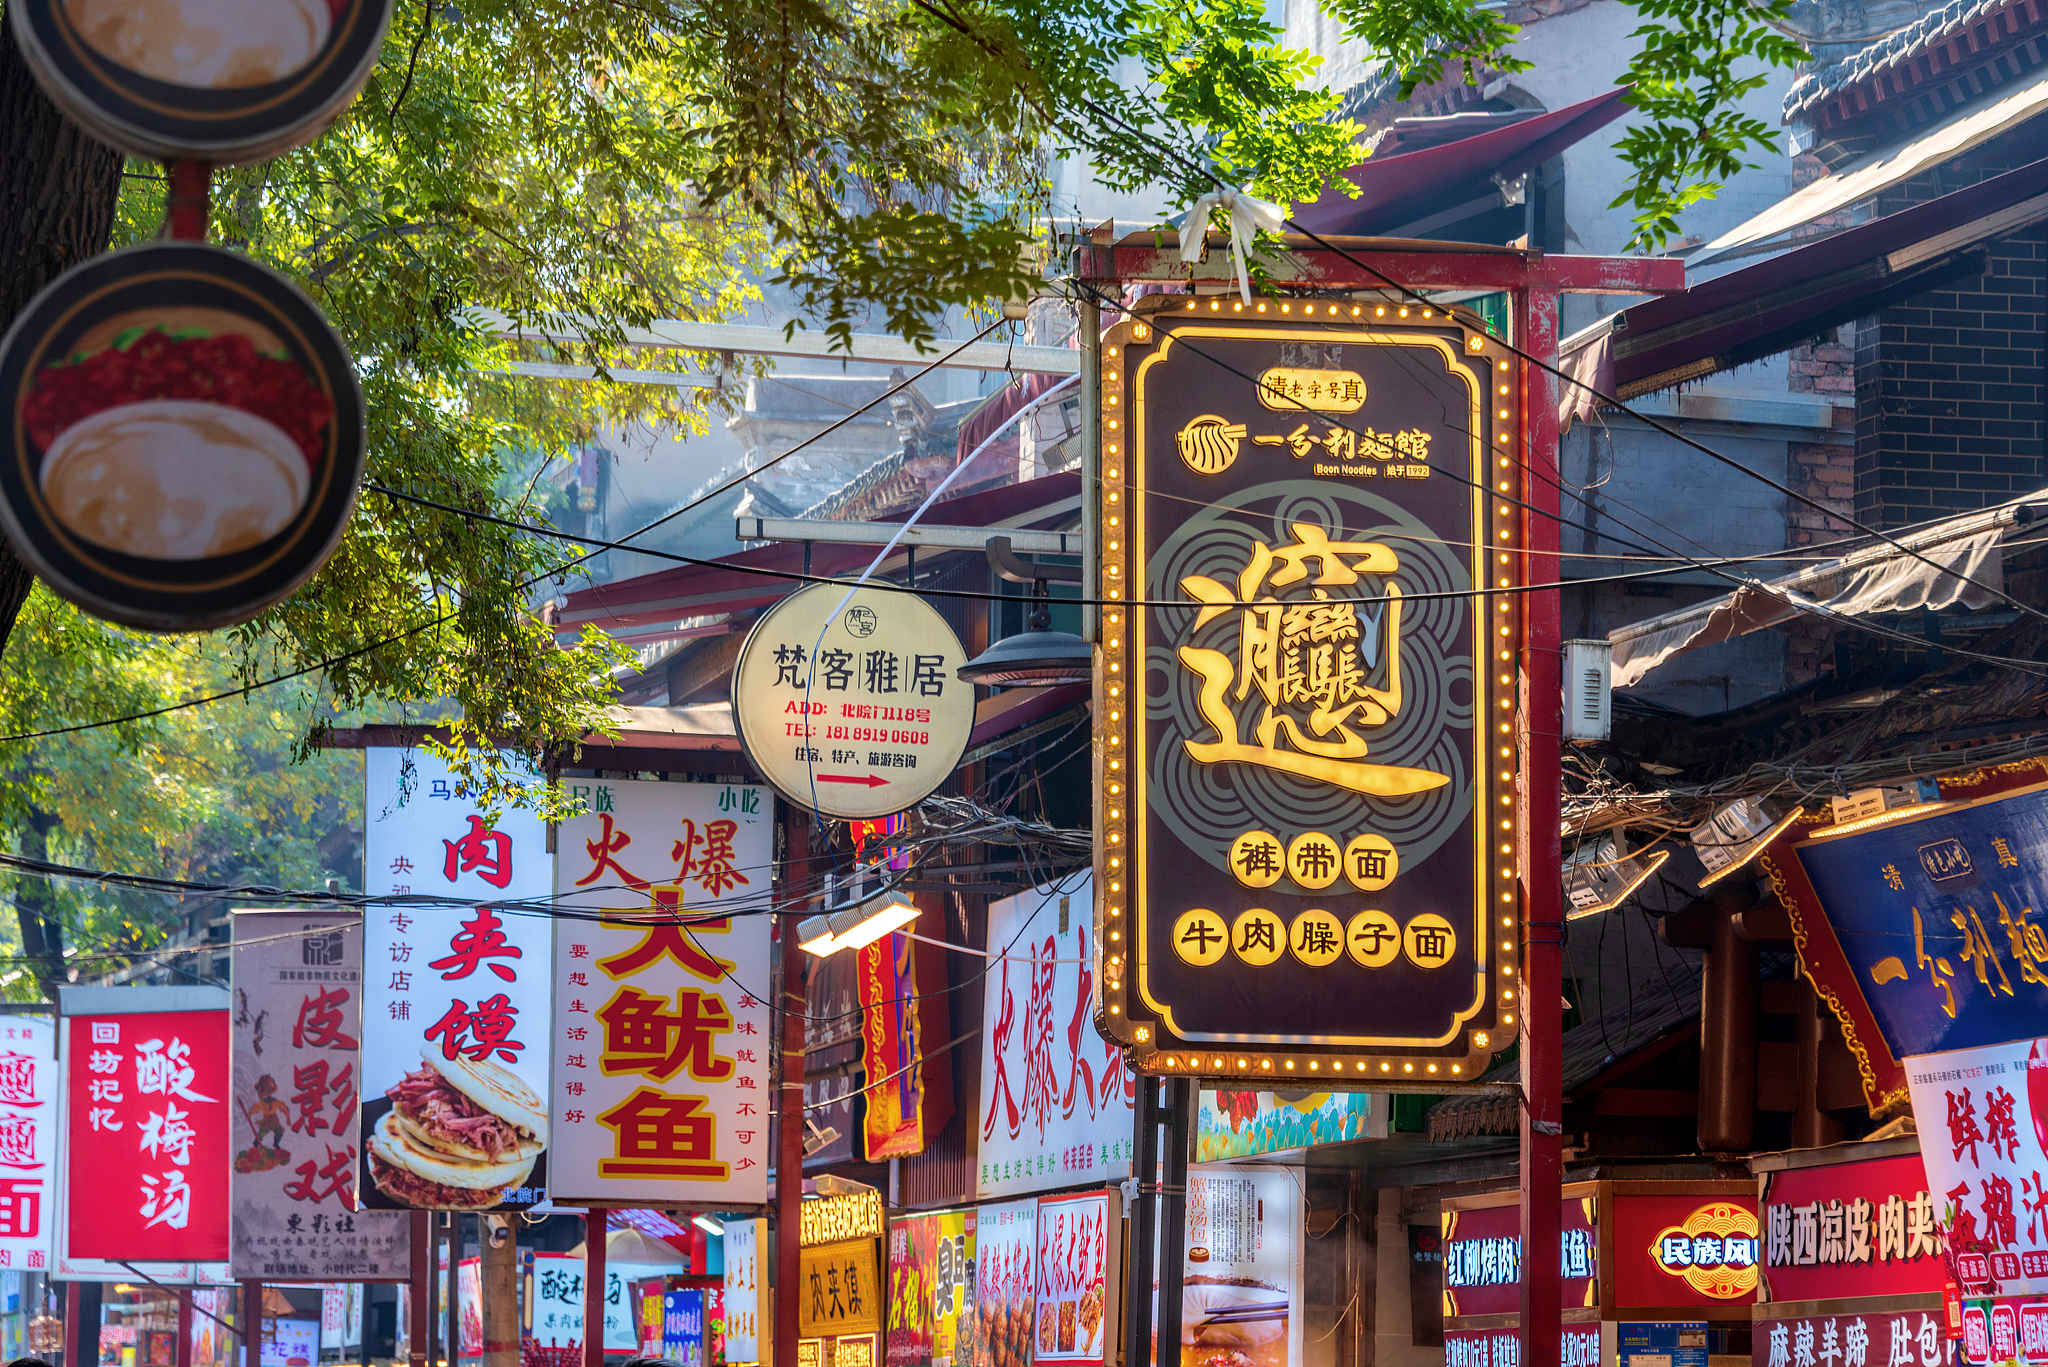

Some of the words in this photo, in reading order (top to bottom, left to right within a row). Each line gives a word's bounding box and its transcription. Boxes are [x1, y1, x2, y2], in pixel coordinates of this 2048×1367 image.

[1316, 464, 1339, 476] Boon
[1341, 464, 1377, 477] Noodles
[772, 643, 947, 698] 梵客雅居
[840, 703, 931, 724] 北院门118号
[573, 785, 615, 814] 民族
[718, 786, 761, 815] 小吃
[575, 813, 750, 898] 火爆
[1235, 840, 1393, 882] 裤带面
[279, 970, 361, 982] 国家级非物质文化遗
[425, 815, 526, 1064] 肉夹馍
[1180, 916, 1452, 960] 牛肉臊子面
[564, 943, 590, 1124] 要想生活过得好
[595, 885, 737, 1181] 大鱿鱼
[88, 1022, 125, 1132] 回坊记忆
[283, 984, 360, 1213] 皮影戏
[734, 993, 759, 1172] 美味鱿鱼不可少
[135, 1036, 220, 1231] 酸梅汤
[1944, 1085, 2022, 1170] 鲜榨
[1188, 1176, 1208, 1244] 蟹黄汤包
[1661, 1236, 1758, 1267] 民族风
[936, 1234, 976, 1319] 臭豆腐
